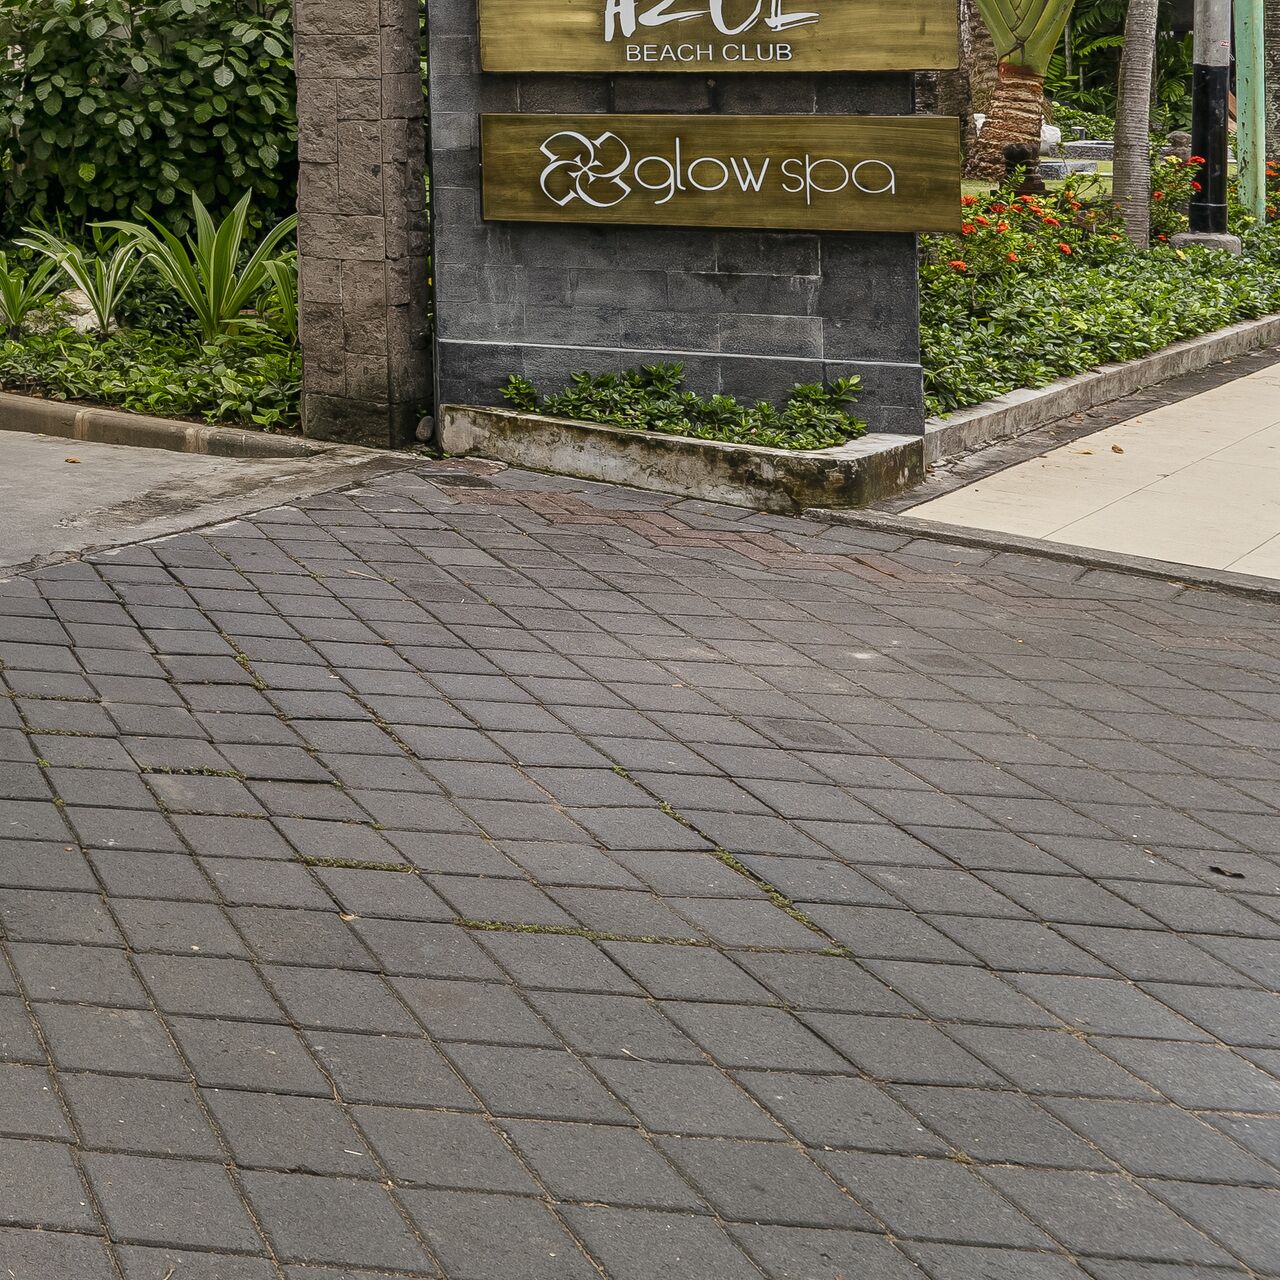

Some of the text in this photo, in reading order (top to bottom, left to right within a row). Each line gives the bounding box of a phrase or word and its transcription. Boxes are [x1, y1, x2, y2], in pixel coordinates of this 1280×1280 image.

[626, 43, 793, 62] BEACH CLUB
[633, 137, 896, 206] glow spa
